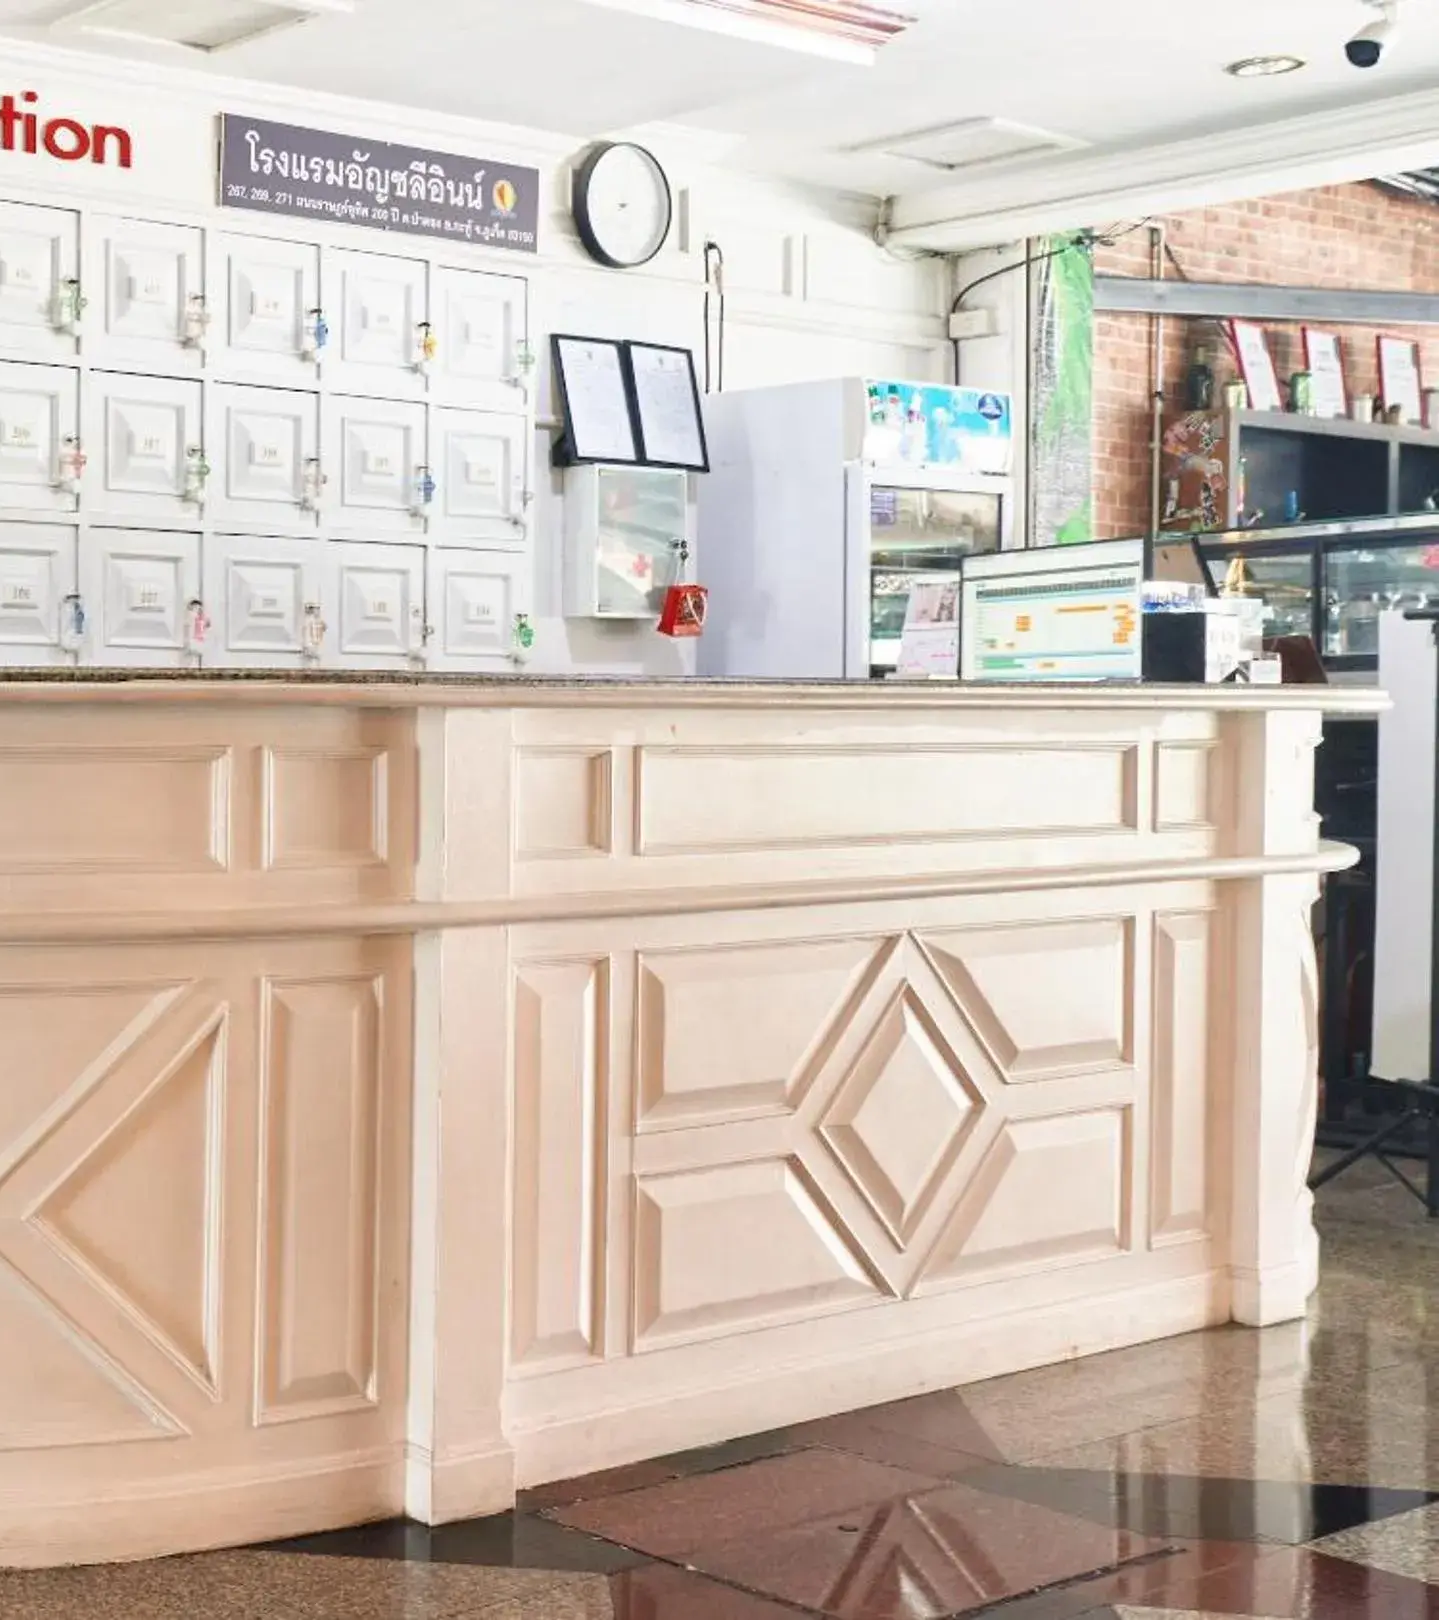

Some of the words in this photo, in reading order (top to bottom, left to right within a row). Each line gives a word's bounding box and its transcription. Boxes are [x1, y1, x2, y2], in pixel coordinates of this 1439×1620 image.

[244, 129, 487, 211] โรงแรมอัญชลีอินน์
